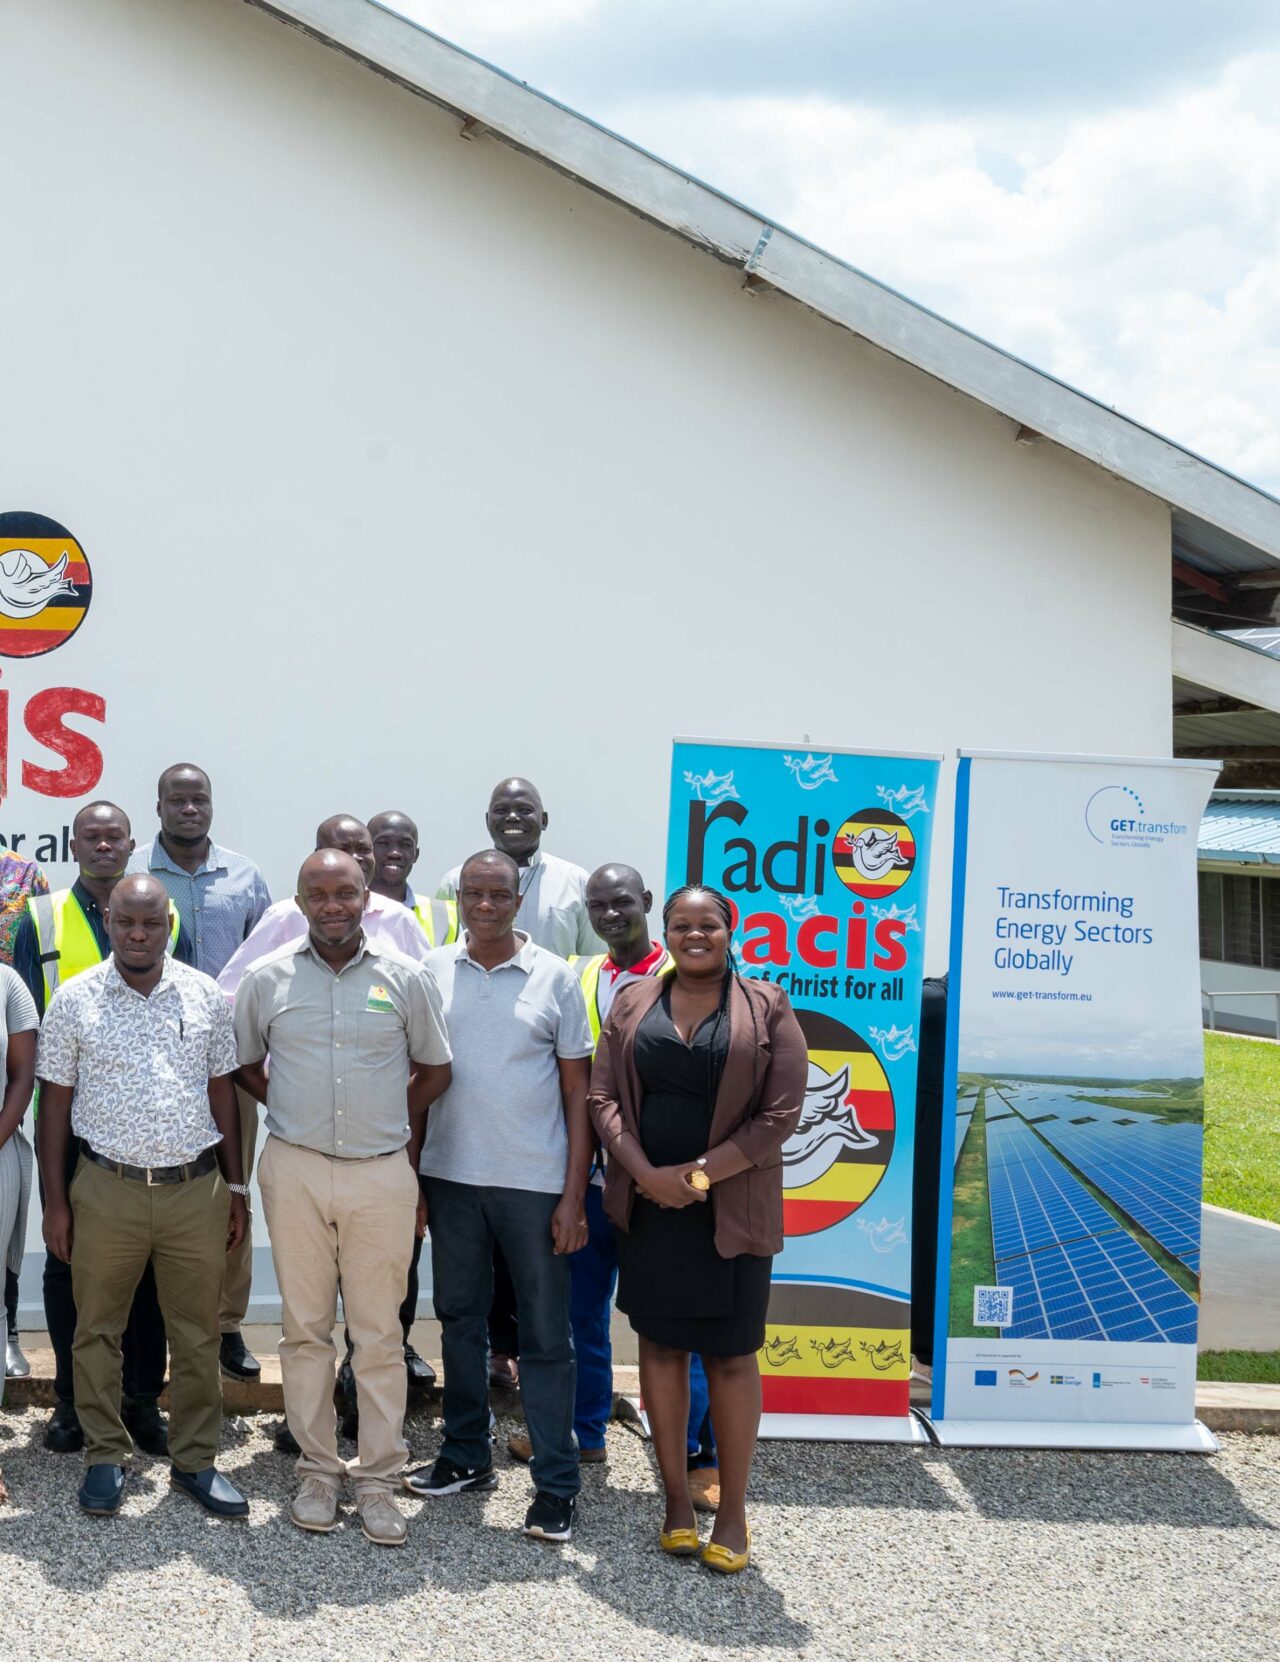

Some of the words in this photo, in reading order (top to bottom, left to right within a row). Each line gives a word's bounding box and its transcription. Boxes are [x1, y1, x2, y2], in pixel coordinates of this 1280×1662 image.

[997, 887, 1134, 918] Transforming
[725, 898, 908, 972] acis
[996, 917, 1067, 945] Energy
[1074, 920, 1153, 944] Sectors
[994, 948, 1073, 976] Globally
[776, 972, 839, 998] Christ
[845, 975, 876, 1000] for
[881, 977, 904, 1001] all
[992, 990, 1092, 1001] www.get-transform.eu
